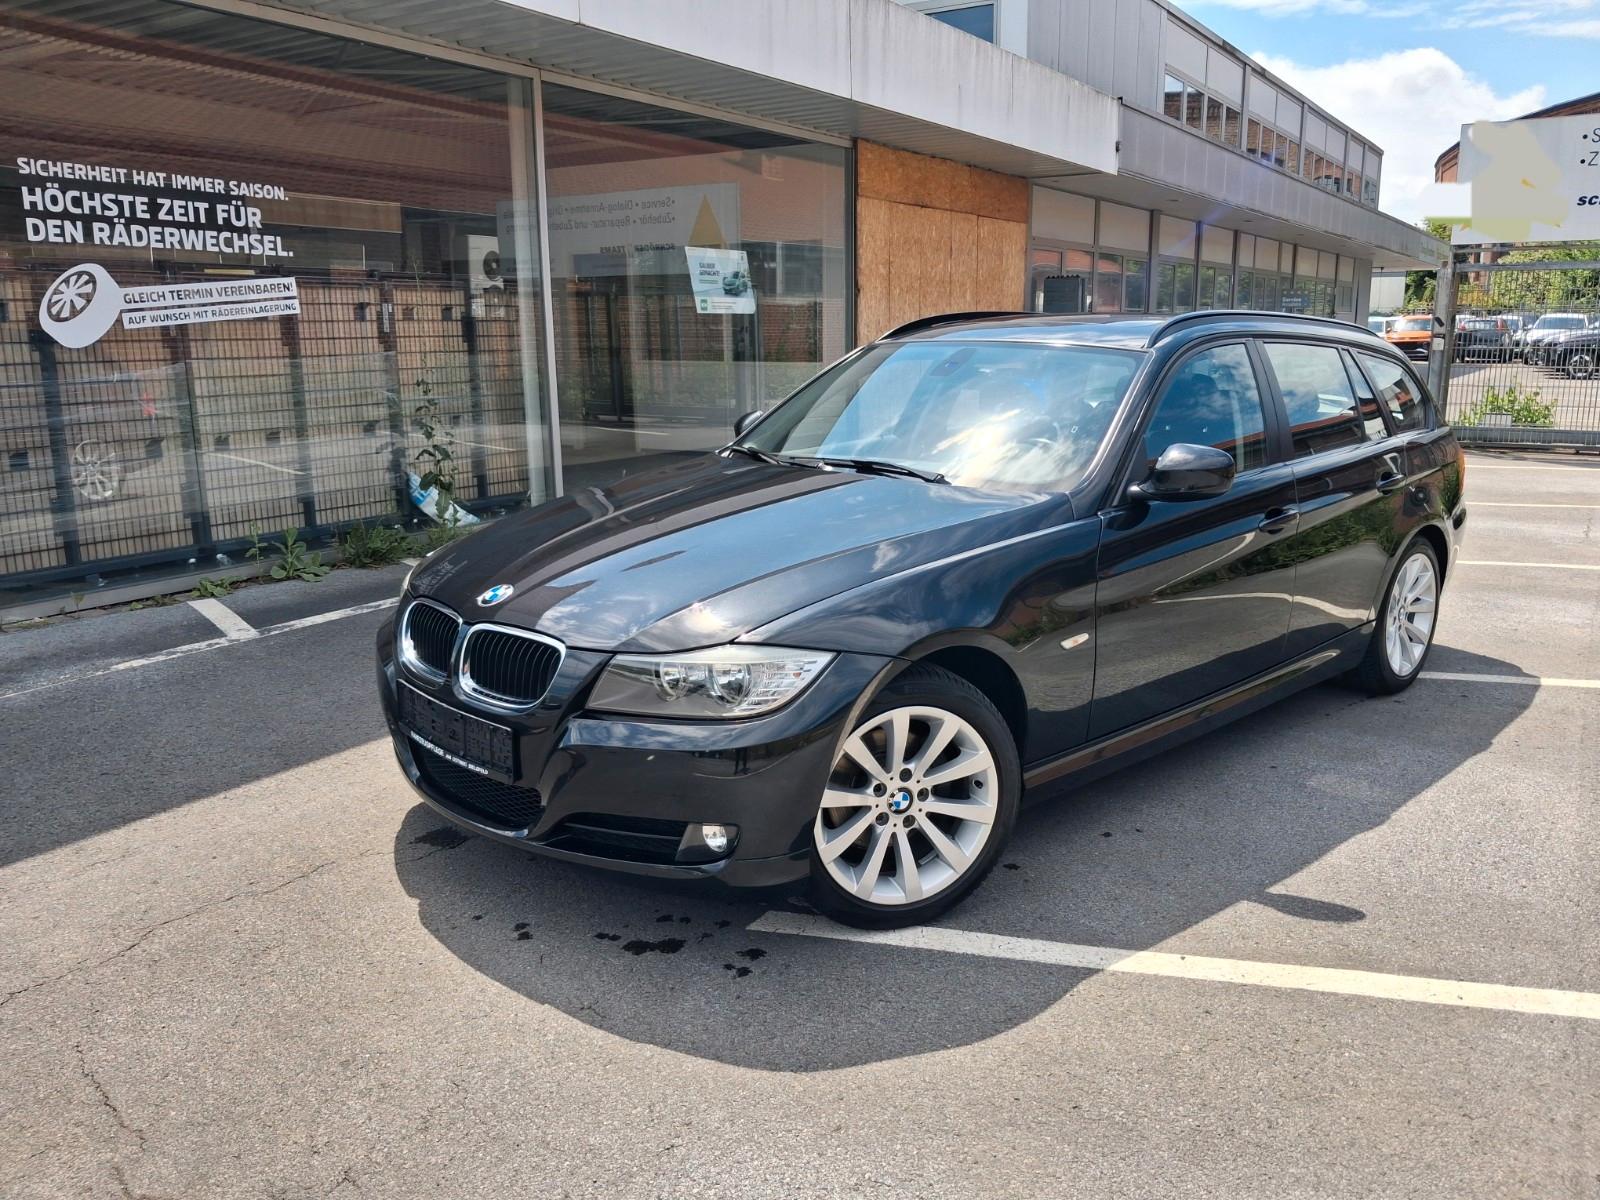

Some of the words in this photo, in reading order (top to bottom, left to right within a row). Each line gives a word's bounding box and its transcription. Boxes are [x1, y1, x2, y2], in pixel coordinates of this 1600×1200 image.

[16, 157, 127, 184] SICHERHEIT
[132, 170, 167, 188] HAT
[172, 174, 225, 194] IMMER
[229, 181, 289, 201] SAISON.
[21, 183, 151, 219] HÖCHSTE
[157, 198, 209, 224] ZEIT
[216, 200, 262, 229] FÜR
[25, 217, 84, 244] DEN
[92, 217, 294, 257] RÄDERWECHSEL.
[123, 291, 166, 305] GLEICH
[168, 287, 213, 302] TERMIN
[215, 282, 294, 299] VEREINBAREN!
[128, 315, 147, 326] AUF
[150, 312, 191, 324] WUNSCH
[193, 310, 209, 320] MIT
[211, 302, 297, 318] RÄDEREINLAGERUNG
